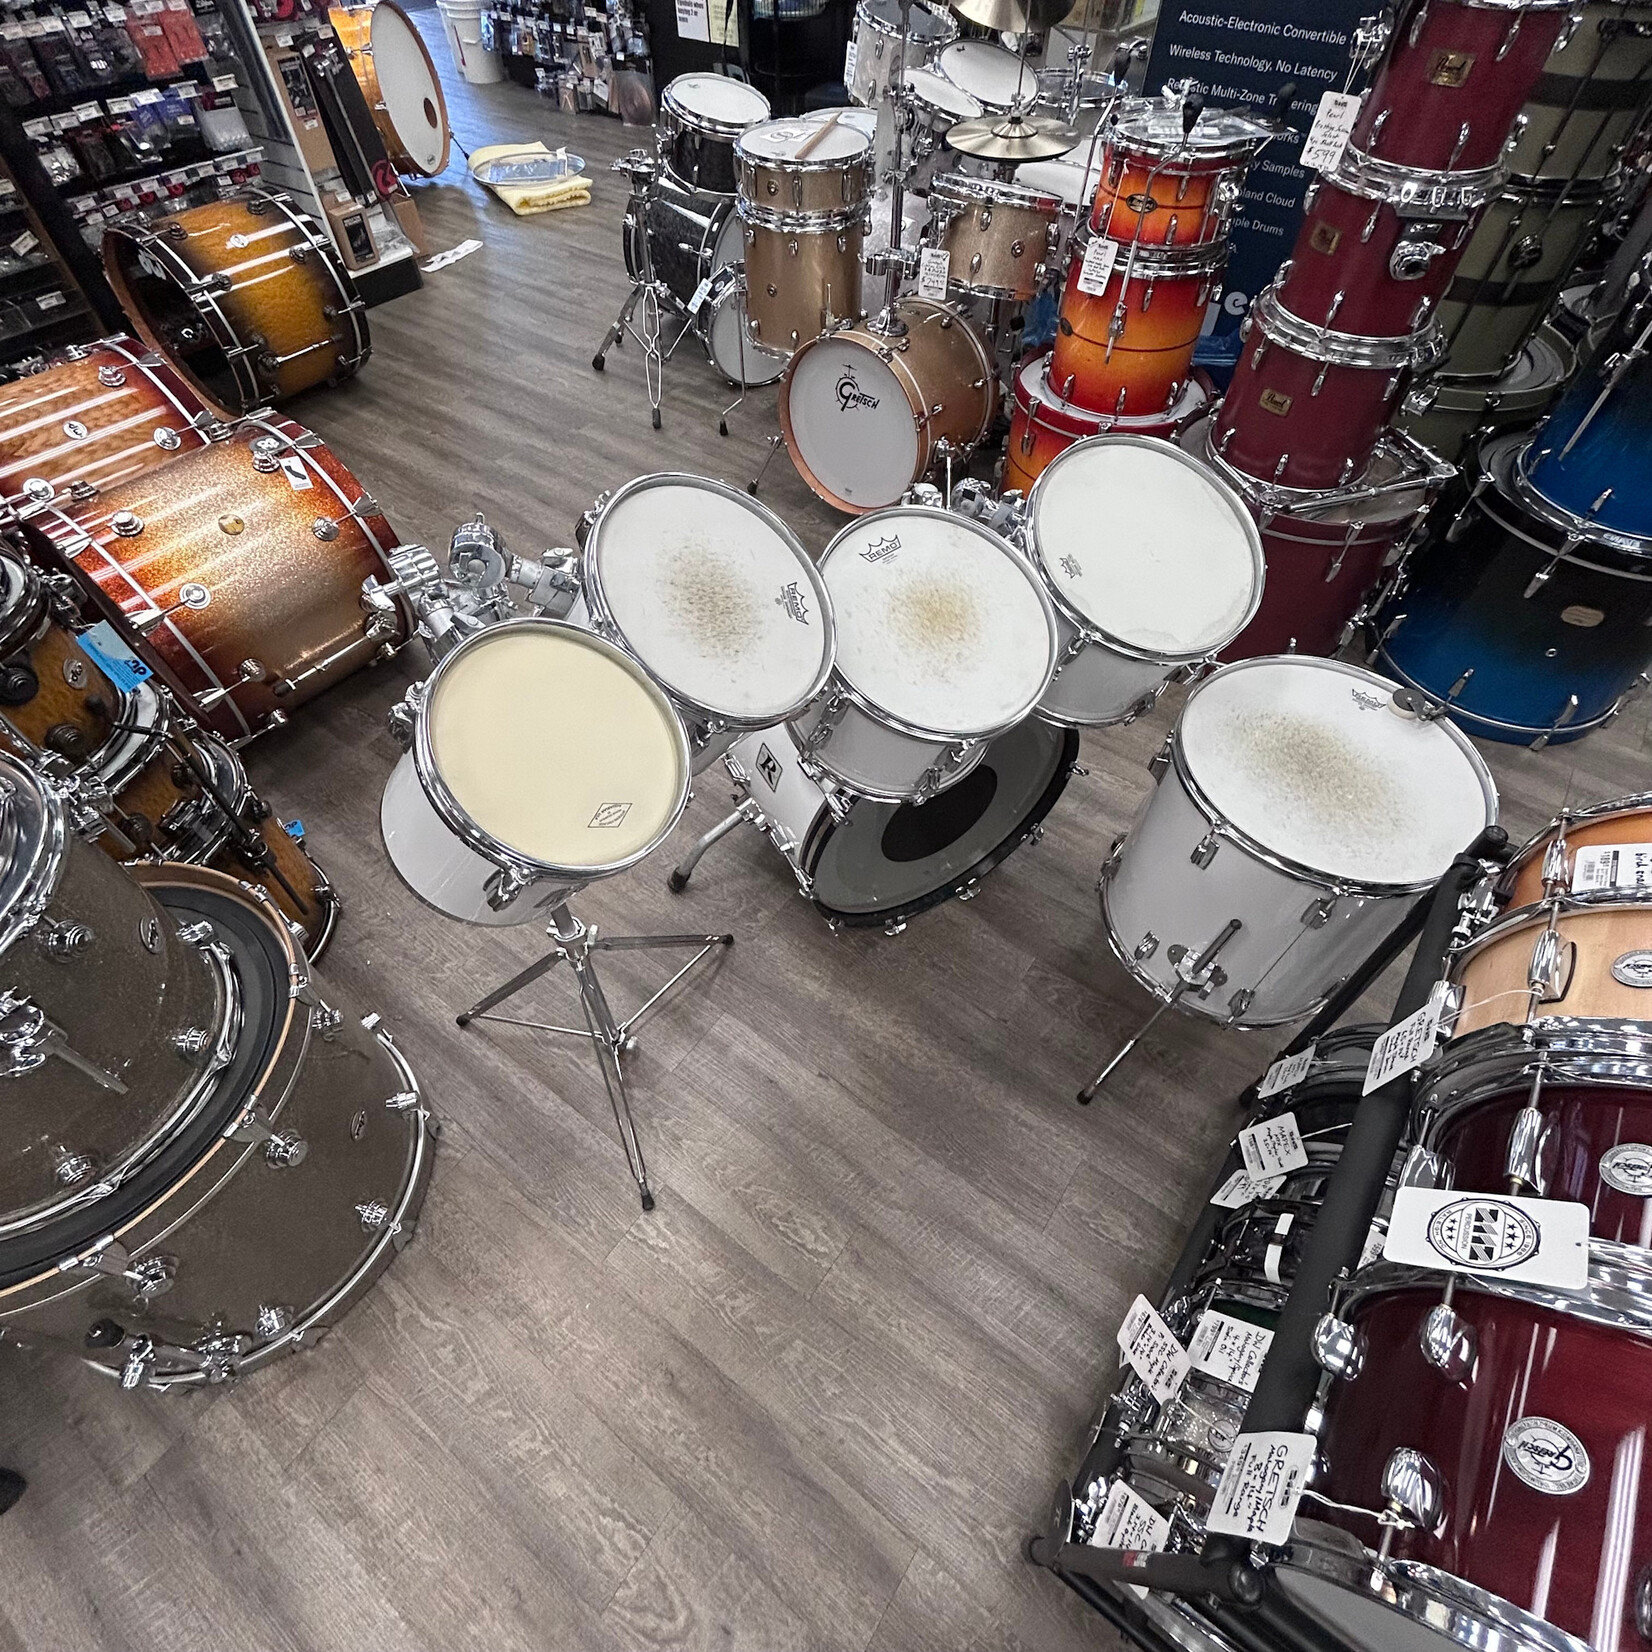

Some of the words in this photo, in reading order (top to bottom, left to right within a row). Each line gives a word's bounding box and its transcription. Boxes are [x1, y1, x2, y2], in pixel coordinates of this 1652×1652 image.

[1179, 10, 1281, 35] Acoustic-Electronic
[1283, 23, 1347, 45] Convertible
[1169, 44, 1211, 61] Wireless
[1214, 50, 1272, 72] Technology,
[1276, 59, 1291, 74] No
[1294, 63, 1338, 83] Latency
[1211, 84, 1265, 105] Multi-Zone
[1326, 107, 1344, 121] Pearl
[1262, 160, 1305, 179] Samples
[1265, 192, 1296, 209] Cloud
[1251, 218, 1284, 236] Drums
[868, 542, 898, 560] REMO
[790, 587, 803, 619] REMO
[760, 752, 777, 785] R
[1406, 1010, 1428, 1063] GRETSCH
[1277, 1124, 1291, 1156] MAPEX
[1460, 1212, 1472, 1249] PERCUSSION
[1516, 1218, 1533, 1239] SINCE
[1436, 1238, 1447, 1249] NC
[1232, 1333, 1239, 1341] 4
[1251, 1331, 1266, 1349] DW
[1156, 1340, 1168, 1356] SSC
[1164, 1343, 1179, 1362] DW
[1218, 1343, 1227, 1354] Oil
[1236, 1349, 1259, 1387] Collector's
[1245, 1453, 1257, 1475] Full
[1251, 1443, 1290, 1532] GRETSCH
[1230, 1480, 1249, 1518] Range
[1132, 1519, 1146, 1543] SSC
[1143, 1514, 1157, 1535] DW
